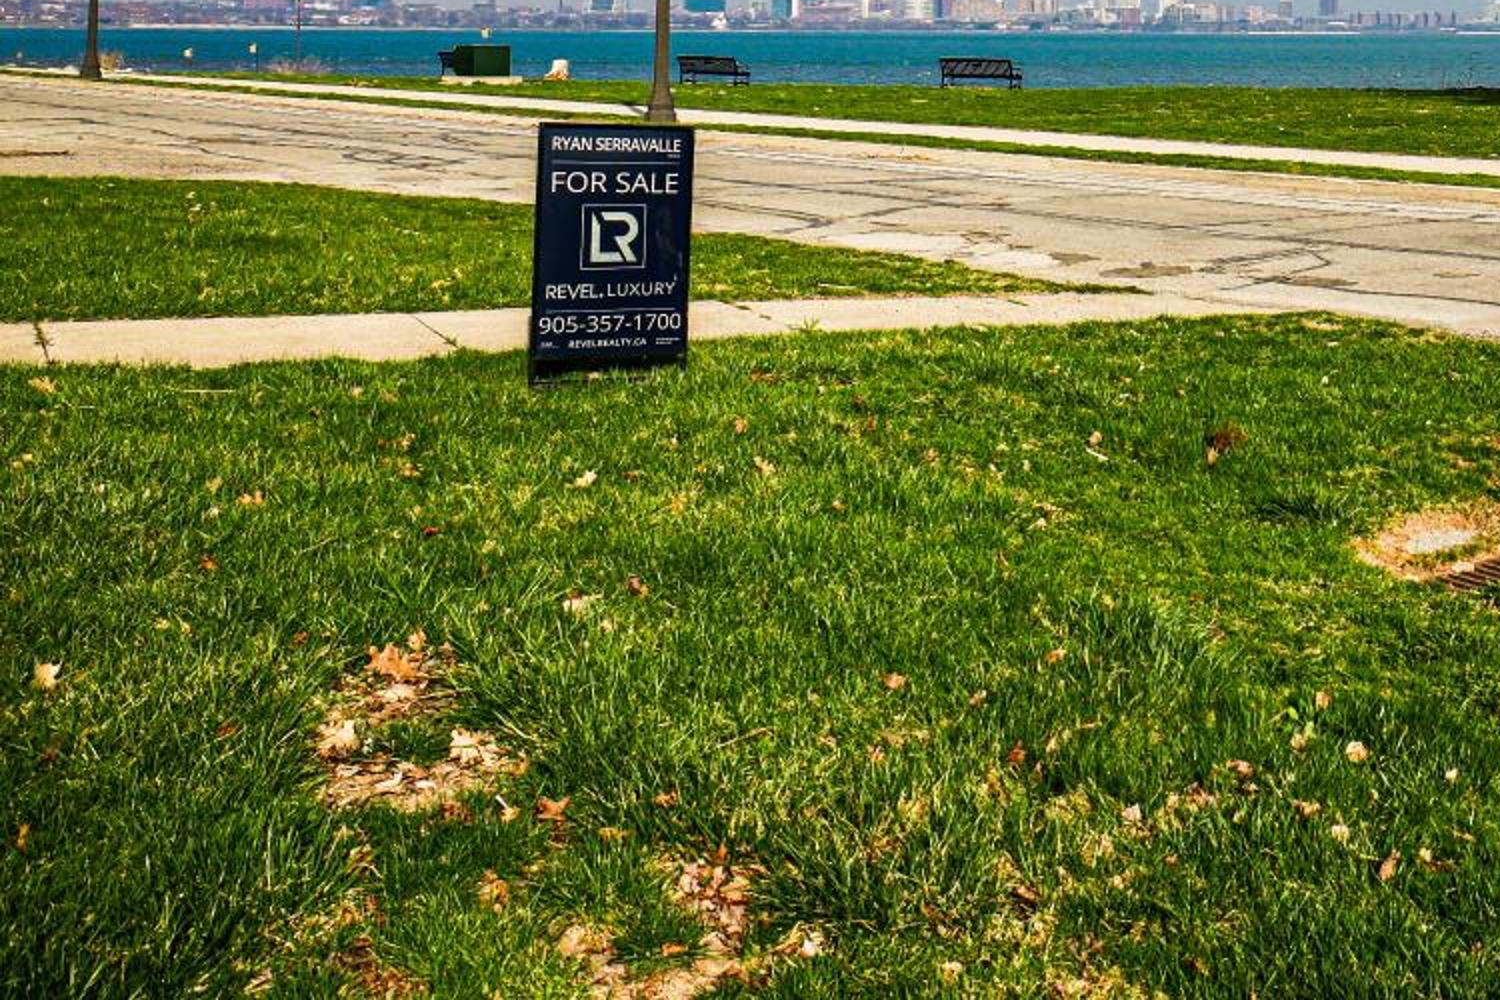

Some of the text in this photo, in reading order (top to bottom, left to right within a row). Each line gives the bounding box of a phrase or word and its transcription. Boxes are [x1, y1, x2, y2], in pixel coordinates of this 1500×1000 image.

[551, 135, 682, 153] RYAN SERRAVALLE
[551, 171, 680, 195] FOR SALE
[607, 281, 676, 297] LUXURY
[538, 313, 682, 335] 905-357-1700
[567, 337, 648, 349] REVELREALTY.CA
